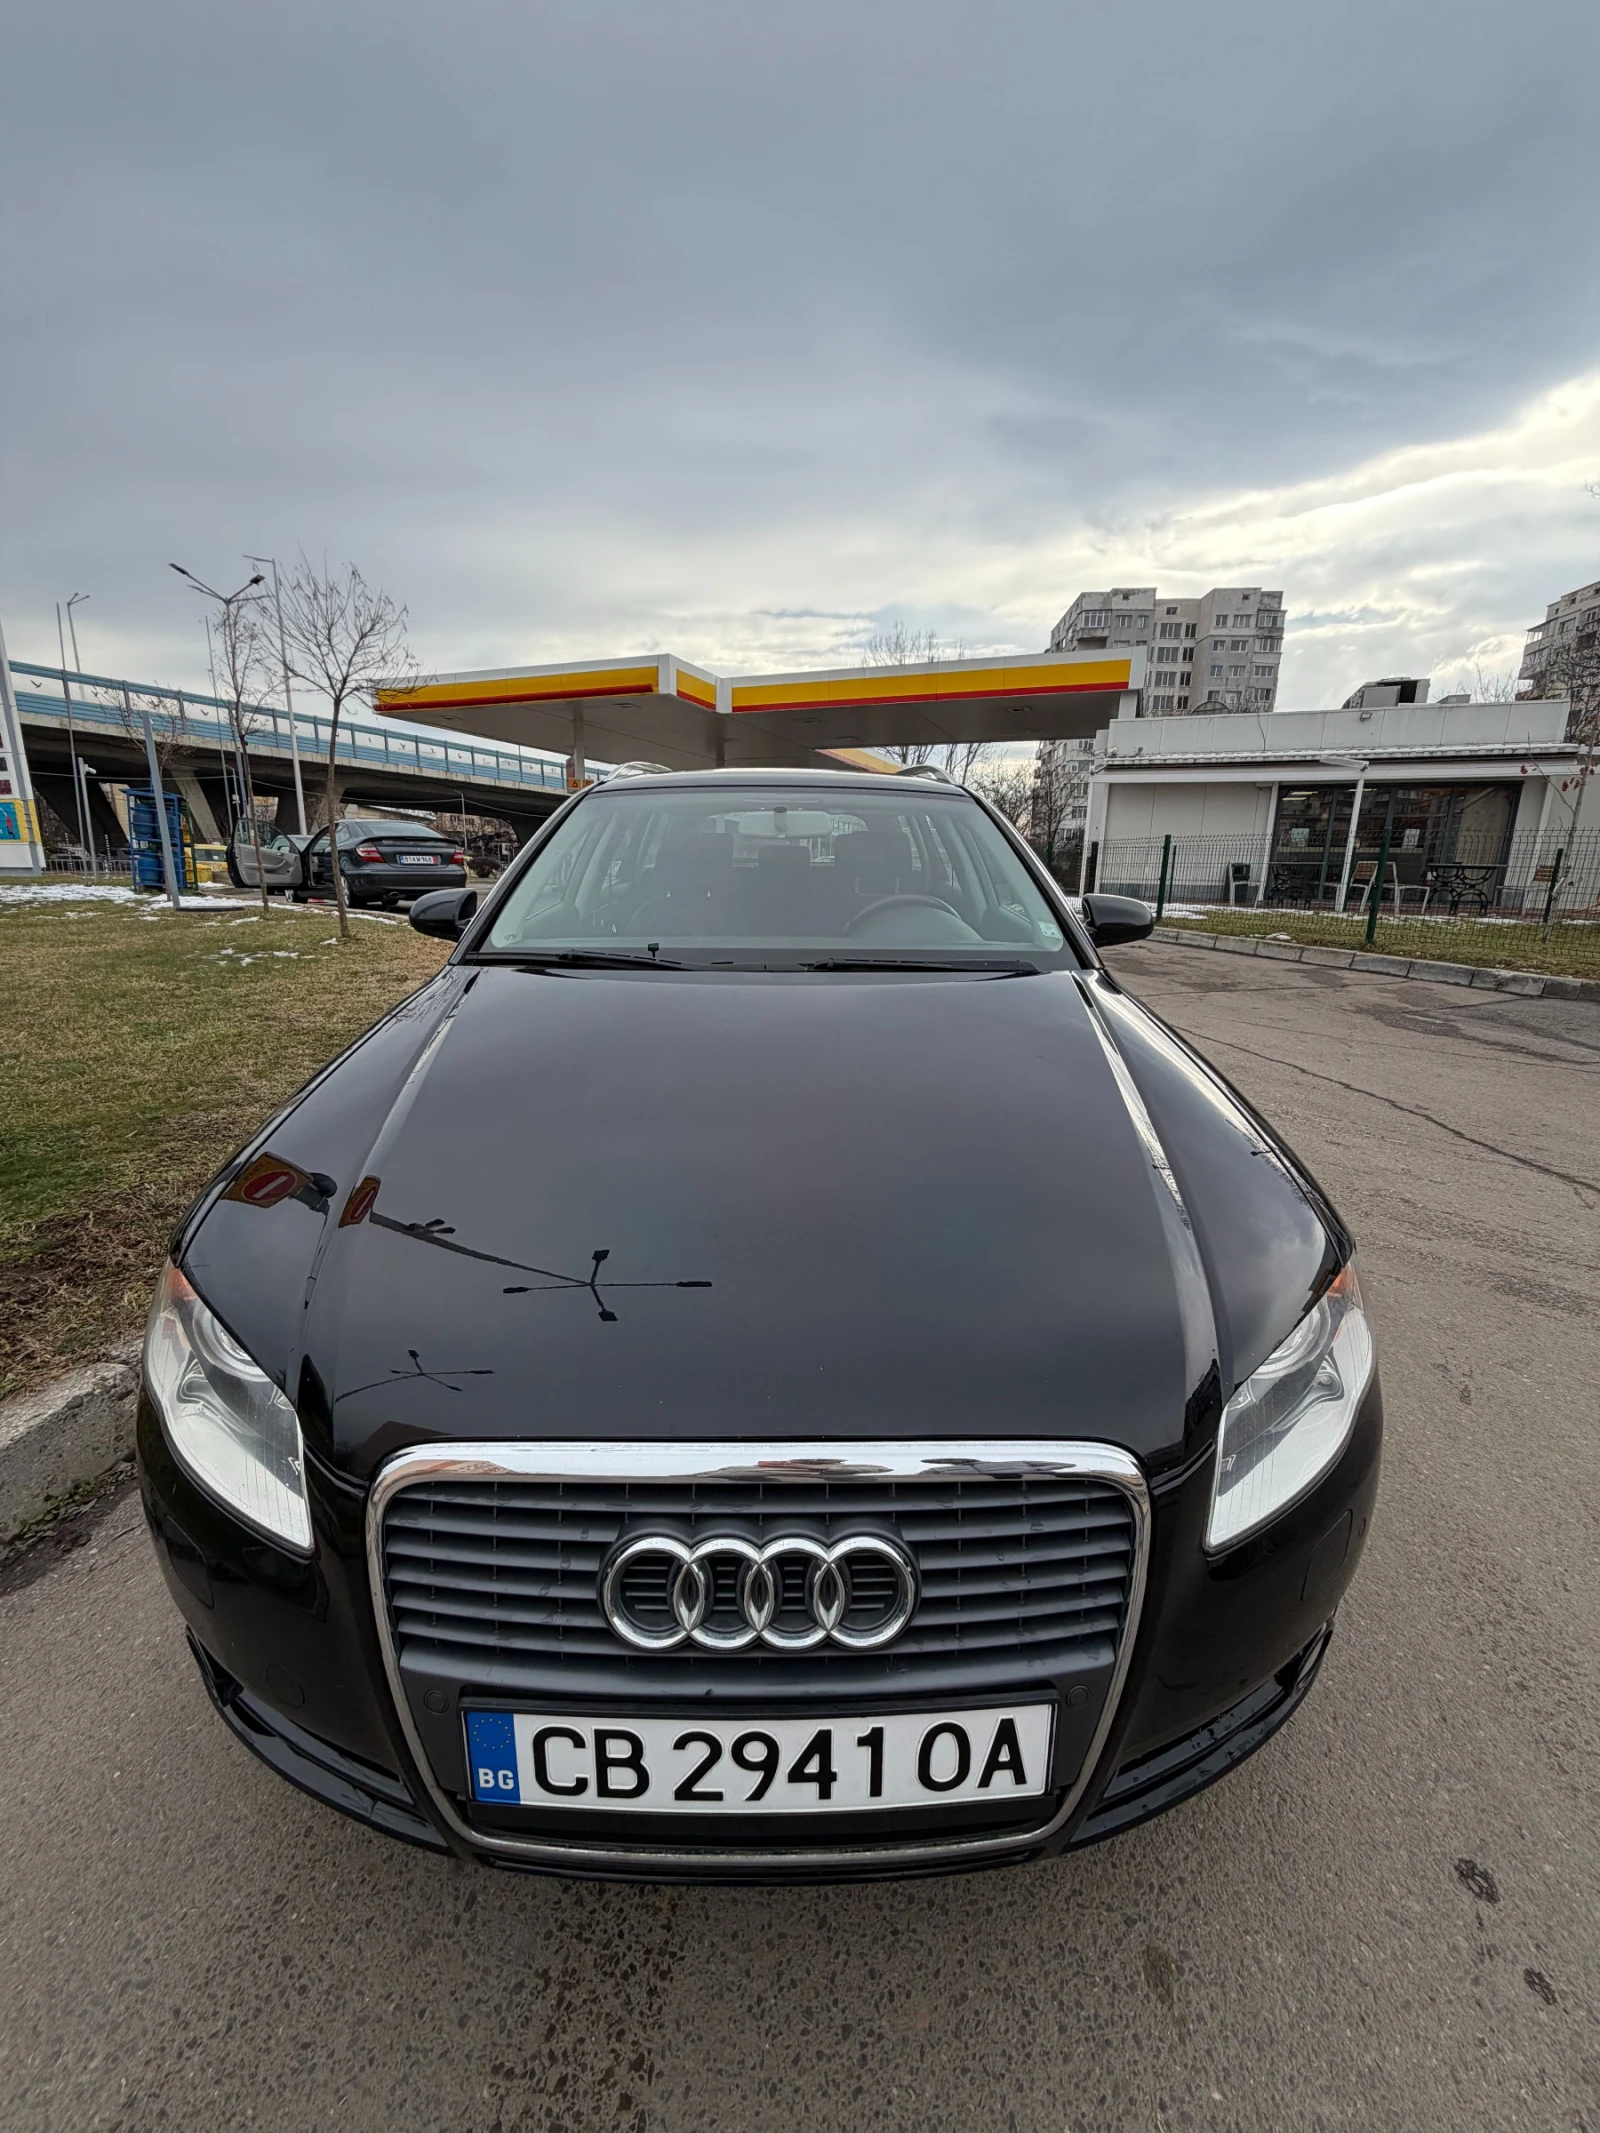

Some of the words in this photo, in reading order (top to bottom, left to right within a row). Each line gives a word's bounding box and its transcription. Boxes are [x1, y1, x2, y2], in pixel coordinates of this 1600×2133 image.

[478, 1767, 515, 1790] BG
[532, 1726, 650, 1799] CB
[672, 1726, 884, 1801] 2941
[917, 1717, 1028, 1793] OA
